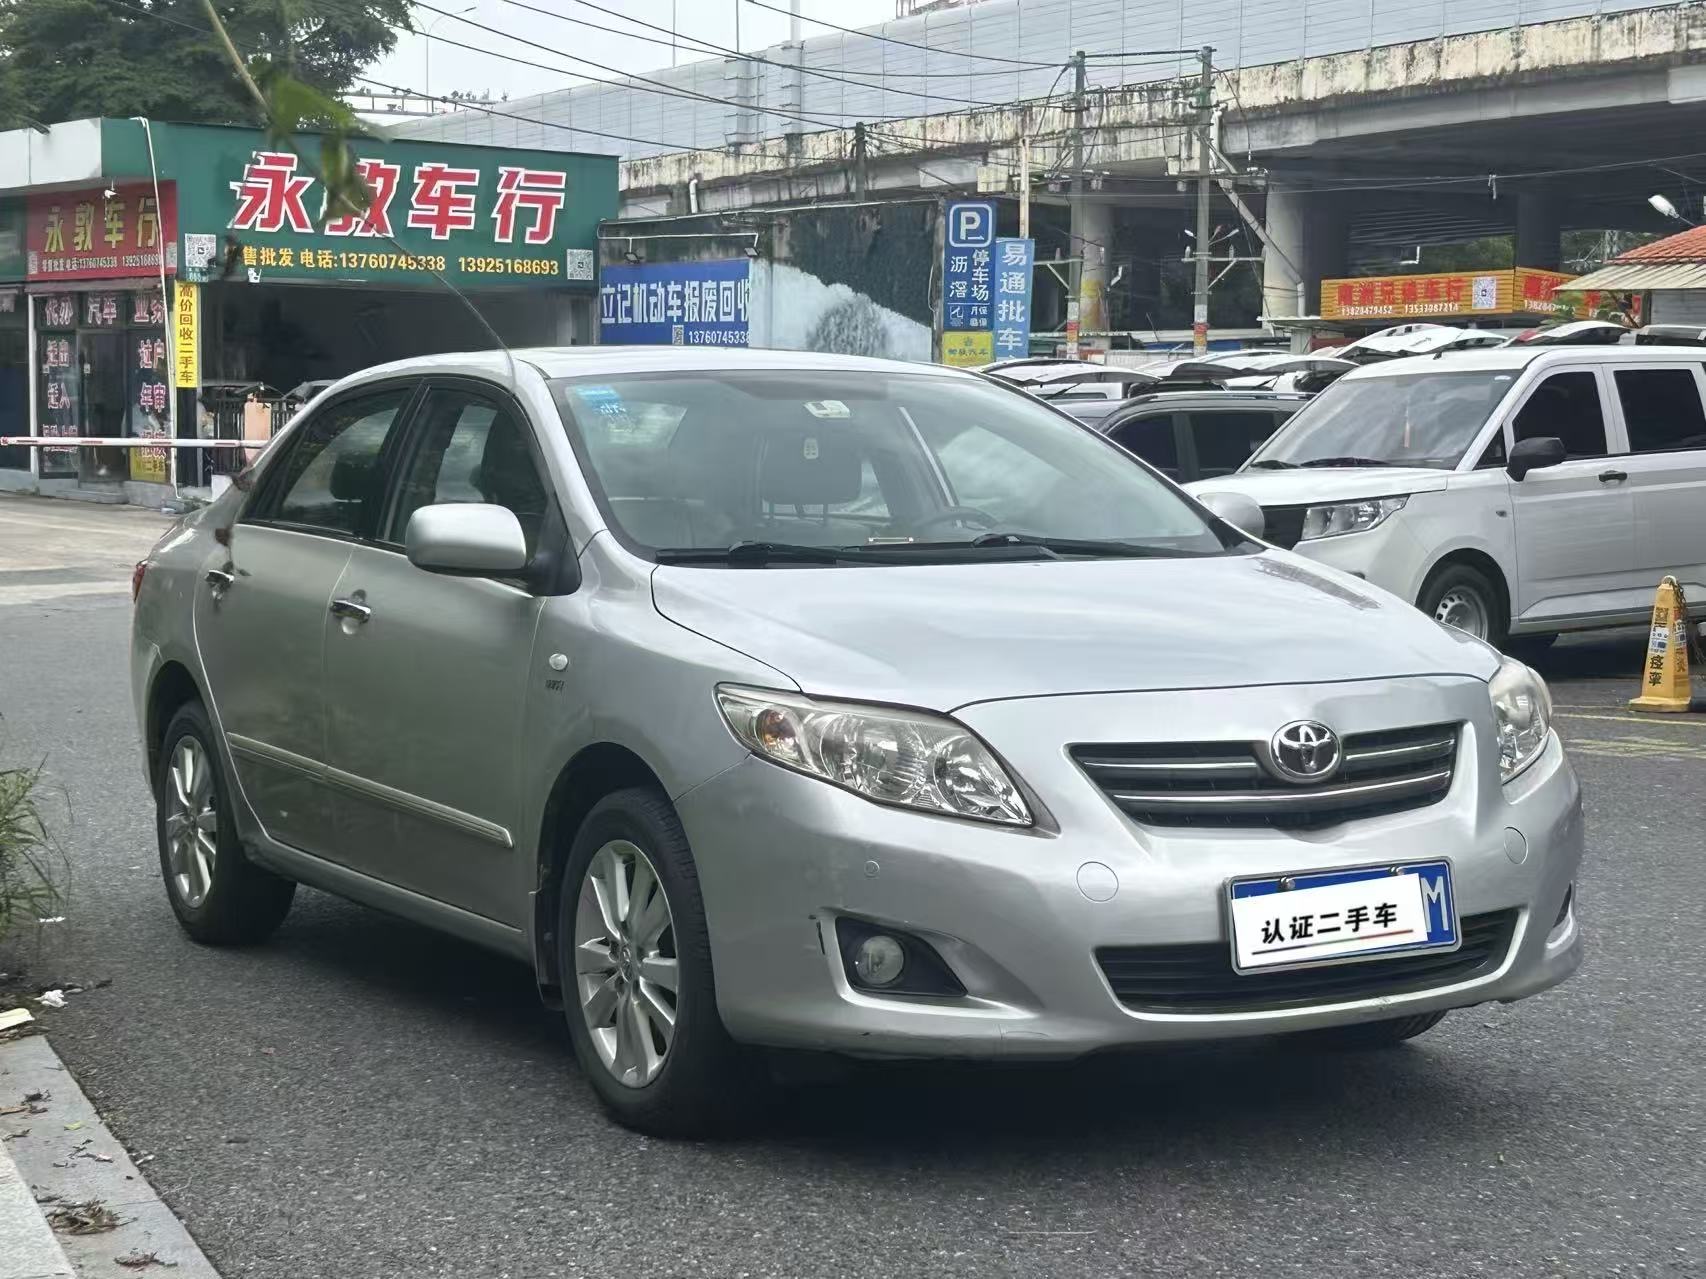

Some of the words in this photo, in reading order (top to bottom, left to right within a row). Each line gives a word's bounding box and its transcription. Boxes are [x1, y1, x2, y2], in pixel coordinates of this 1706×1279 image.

[45, 198, 159, 252] 永敦车行
[226, 245, 294, 267] 售批发
[458, 256, 559, 275] 13925168693
[949, 255, 968, 299] 沥滘
[971, 249, 990, 301] 停车场
[44, 295, 74, 326] 代办
[87, 297, 117, 325] 汽车
[996, 243, 1027, 362] 易通批车
[179, 284, 194, 383] 高价回收二手车
[140, 382, 167, 413] 年审
[1421, 876, 1448, 932] M
